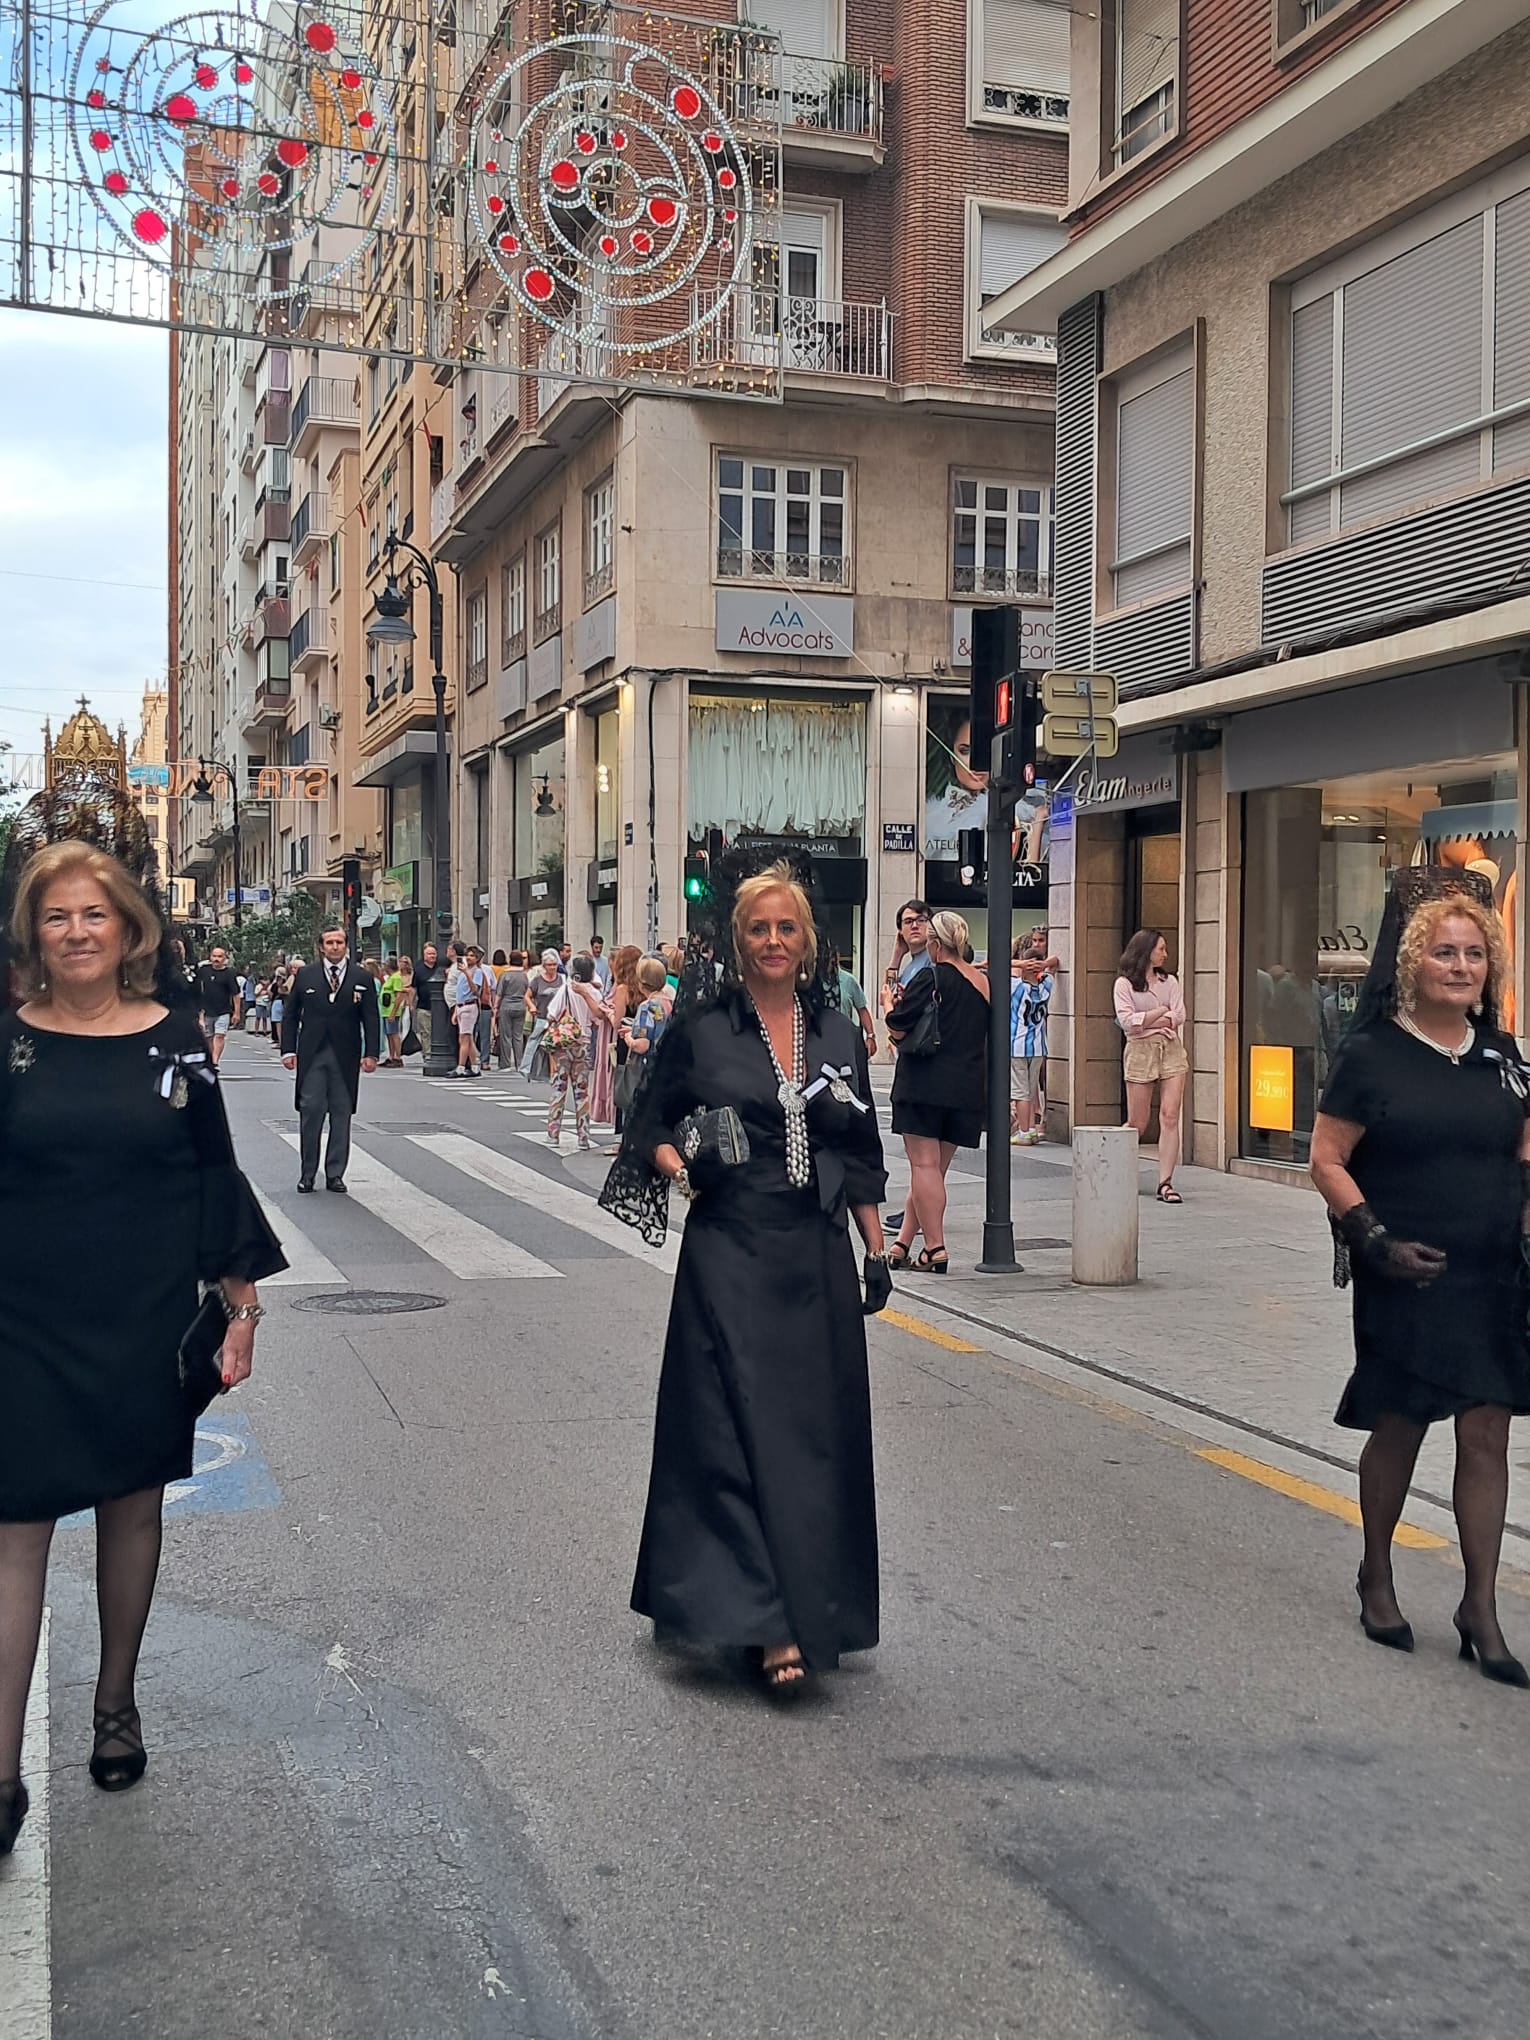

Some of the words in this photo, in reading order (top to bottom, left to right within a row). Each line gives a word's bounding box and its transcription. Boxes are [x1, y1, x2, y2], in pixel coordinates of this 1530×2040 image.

[738, 626, 834, 650] Advocats
[885, 825, 913, 834] CALLE
[884, 840, 913, 850] PADILLA
[925, 839, 960, 851] ATELI
